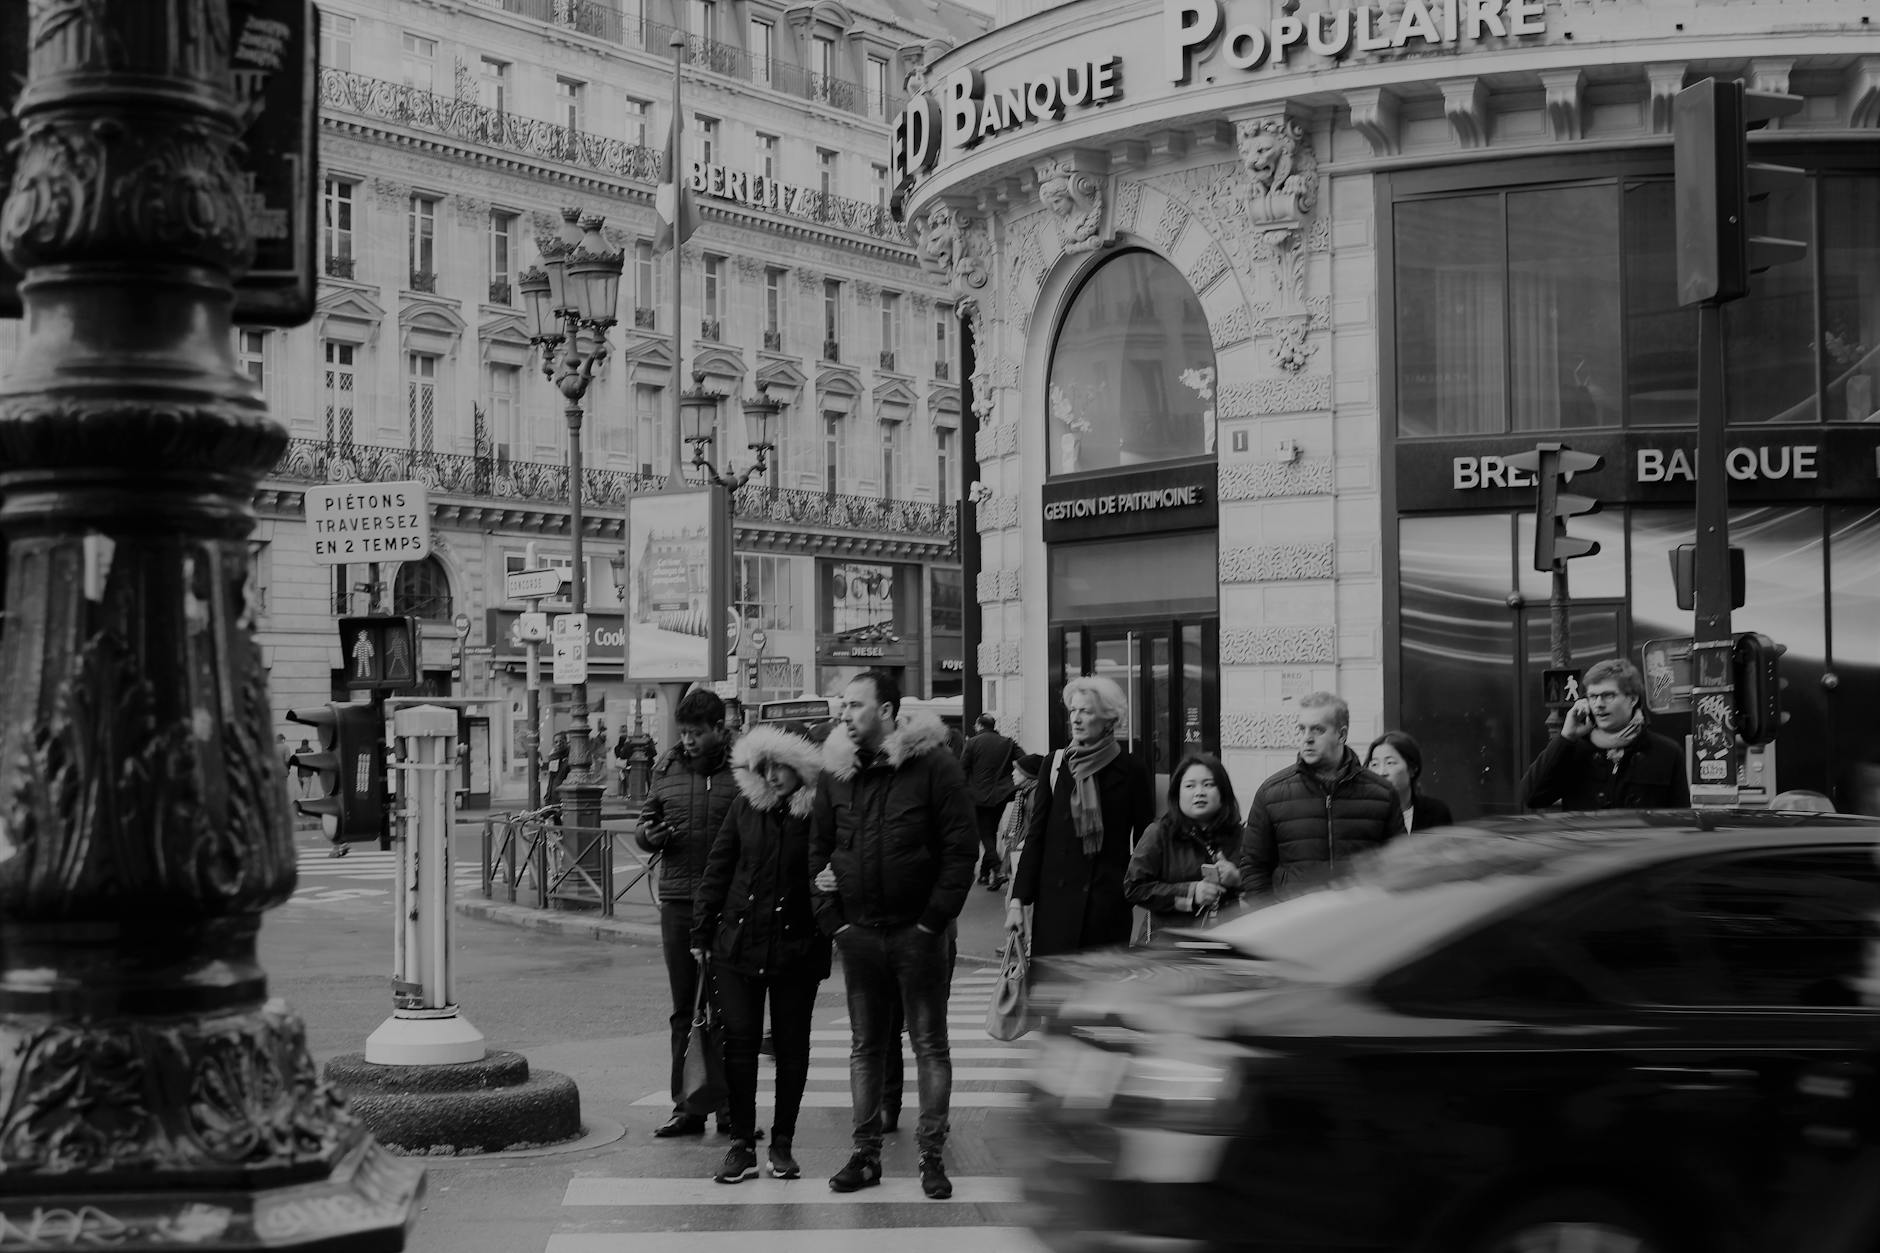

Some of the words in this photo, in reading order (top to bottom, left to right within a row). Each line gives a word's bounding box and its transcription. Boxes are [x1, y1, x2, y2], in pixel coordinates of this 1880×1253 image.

[946, 56, 1118, 148] BANQUE
[1163, 0, 1546, 84] POPULAIRE
[690, 160, 808, 216] BERLITZ
[1453, 455, 1574, 490] BRE
[1637, 445, 1818, 483] BAQUE
[325, 493, 406, 511] PIÉTONS
[1044, 498, 1096, 521] GESTION
[1098, 494, 1117, 516] DE
[1118, 485, 1197, 512] PATRIMOINE
[315, 514, 419, 533] TRAVERSEZ
[315, 540, 336, 555] EN
[345, 539, 354, 554] 2
[363, 536, 421, 552] TEMPS
[851, 646, 884, 657] DIESEL
